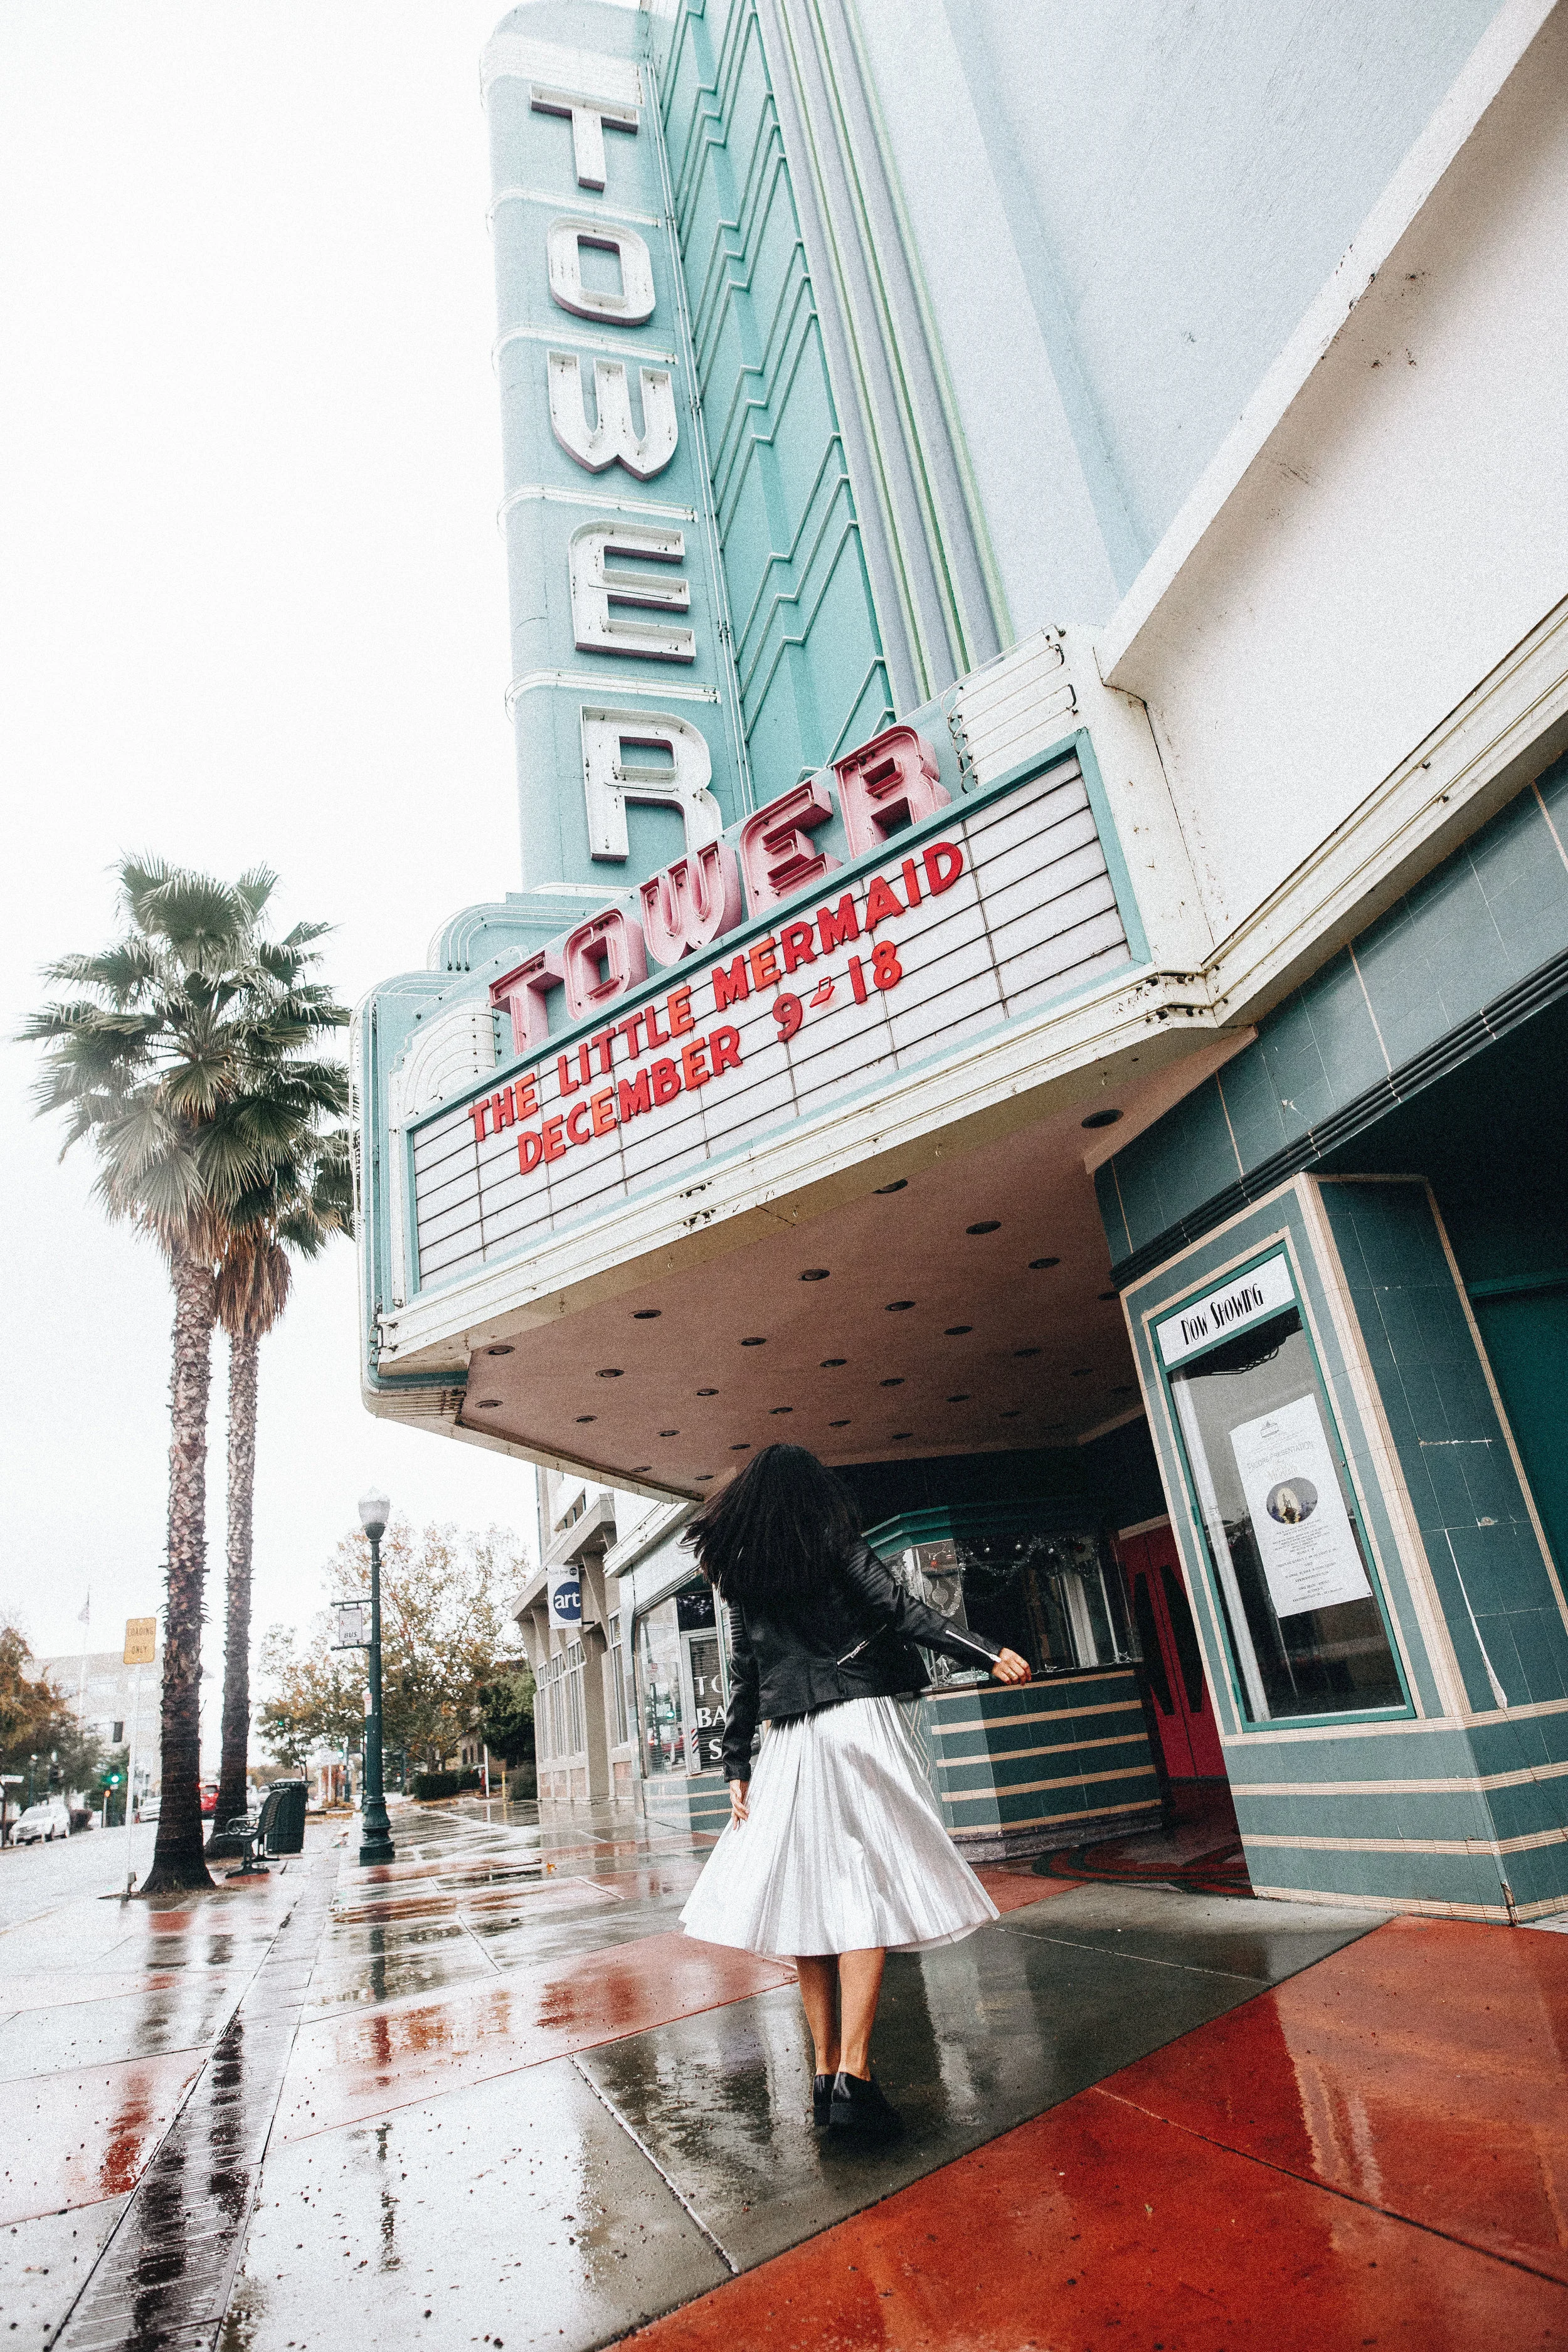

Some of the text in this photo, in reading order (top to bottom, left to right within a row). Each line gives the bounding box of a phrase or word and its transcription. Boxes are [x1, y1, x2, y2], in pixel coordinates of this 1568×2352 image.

[531, 83, 723, 862] TOWER
[469, 842, 964, 1142] THE LITTLE MERMAID
[489, 725, 951, 1056] TOWER
[517, 1025, 743, 1175] DECEMBER
[1180, 1283, 1264, 1345] NOW SHOWING
[554, 1592, 581, 1609] art
